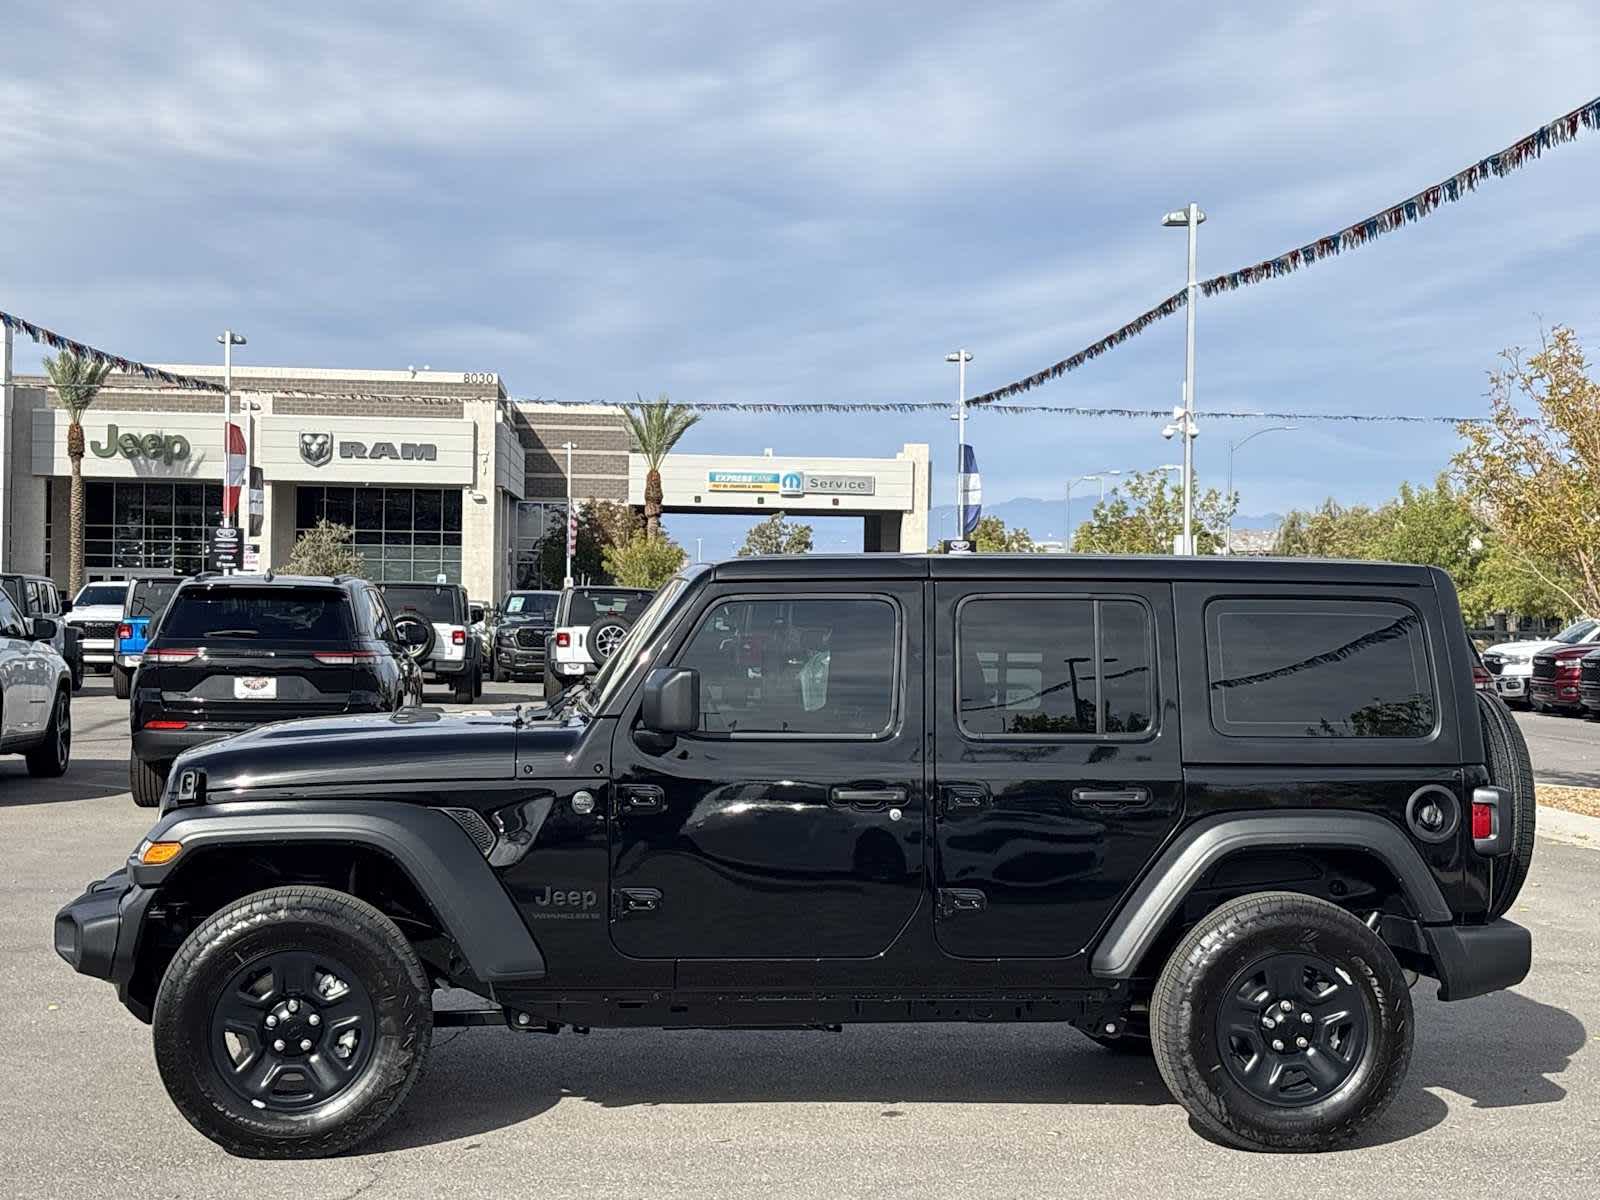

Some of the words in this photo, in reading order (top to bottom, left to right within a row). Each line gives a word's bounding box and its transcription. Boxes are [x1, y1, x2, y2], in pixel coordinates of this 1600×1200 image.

[464, 373, 493, 384] 8030
[90, 424, 191, 466] Jeep
[339, 441, 437, 461] RAM
[810, 478, 866, 489] Service
[535, 886, 597, 910] Jeep
